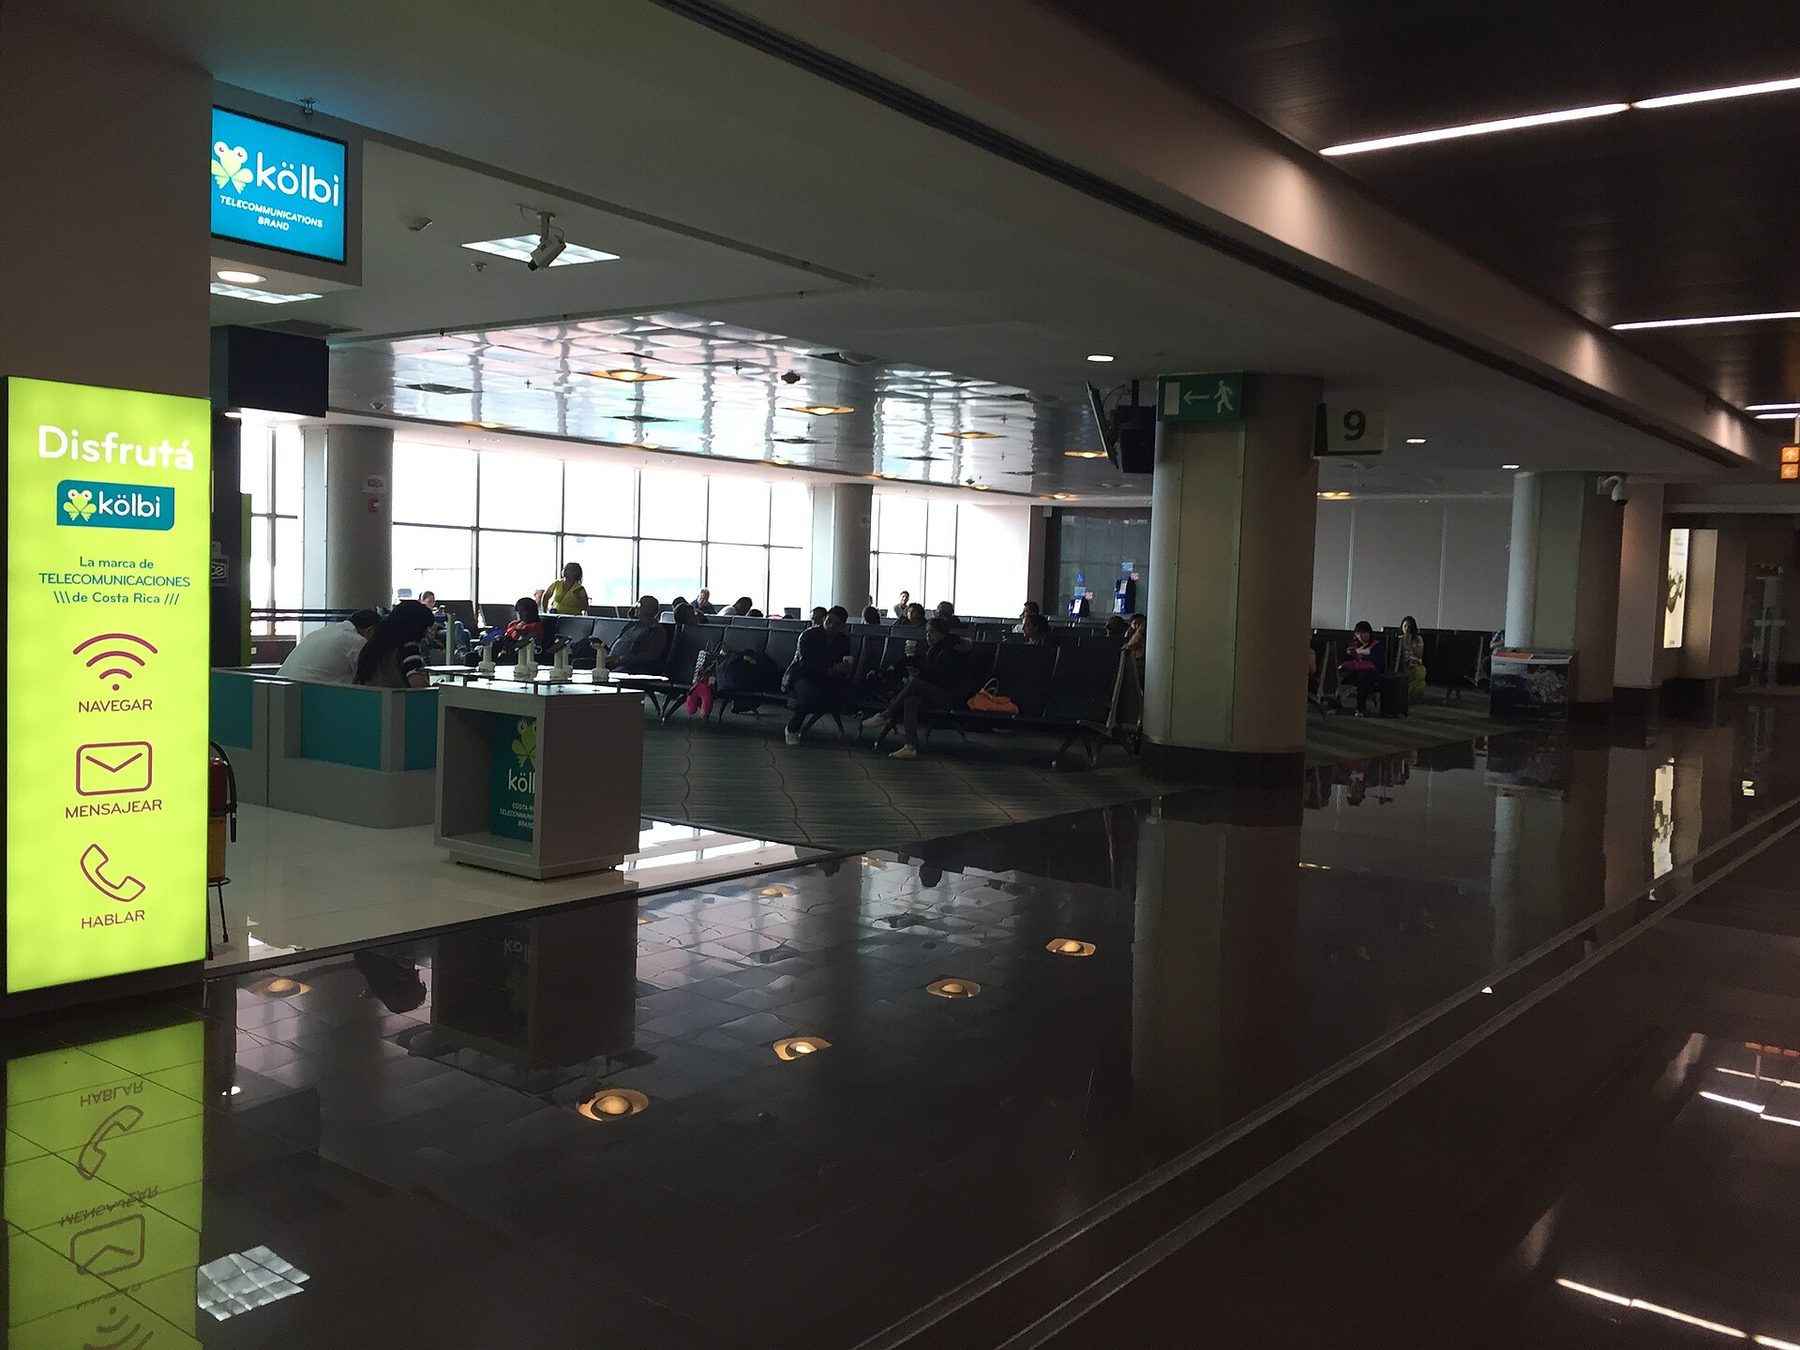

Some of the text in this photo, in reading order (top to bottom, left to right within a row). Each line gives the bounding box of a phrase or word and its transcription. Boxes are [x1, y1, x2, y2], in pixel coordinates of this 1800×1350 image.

[256, 151, 340, 207] kölbi
[219, 195, 324, 229] TELECOMMUNICATIONS
[257, 216, 290, 232] BRAND
[1343, 409, 1366, 441] 9
[38, 425, 194, 471] Disfrutá
[98, 490, 161, 519] kölbi
[80, 556, 155, 570] La marca de
[38, 572, 191, 588] TELECOMUNICACIONES
[92, 591, 129, 604] Costa
[133, 592, 160, 605] Rica
[78, 698, 153, 713] NAVEGAR
[65, 799, 162, 819] MENSAJEAR
[81, 910, 145, 929] HABLAR
